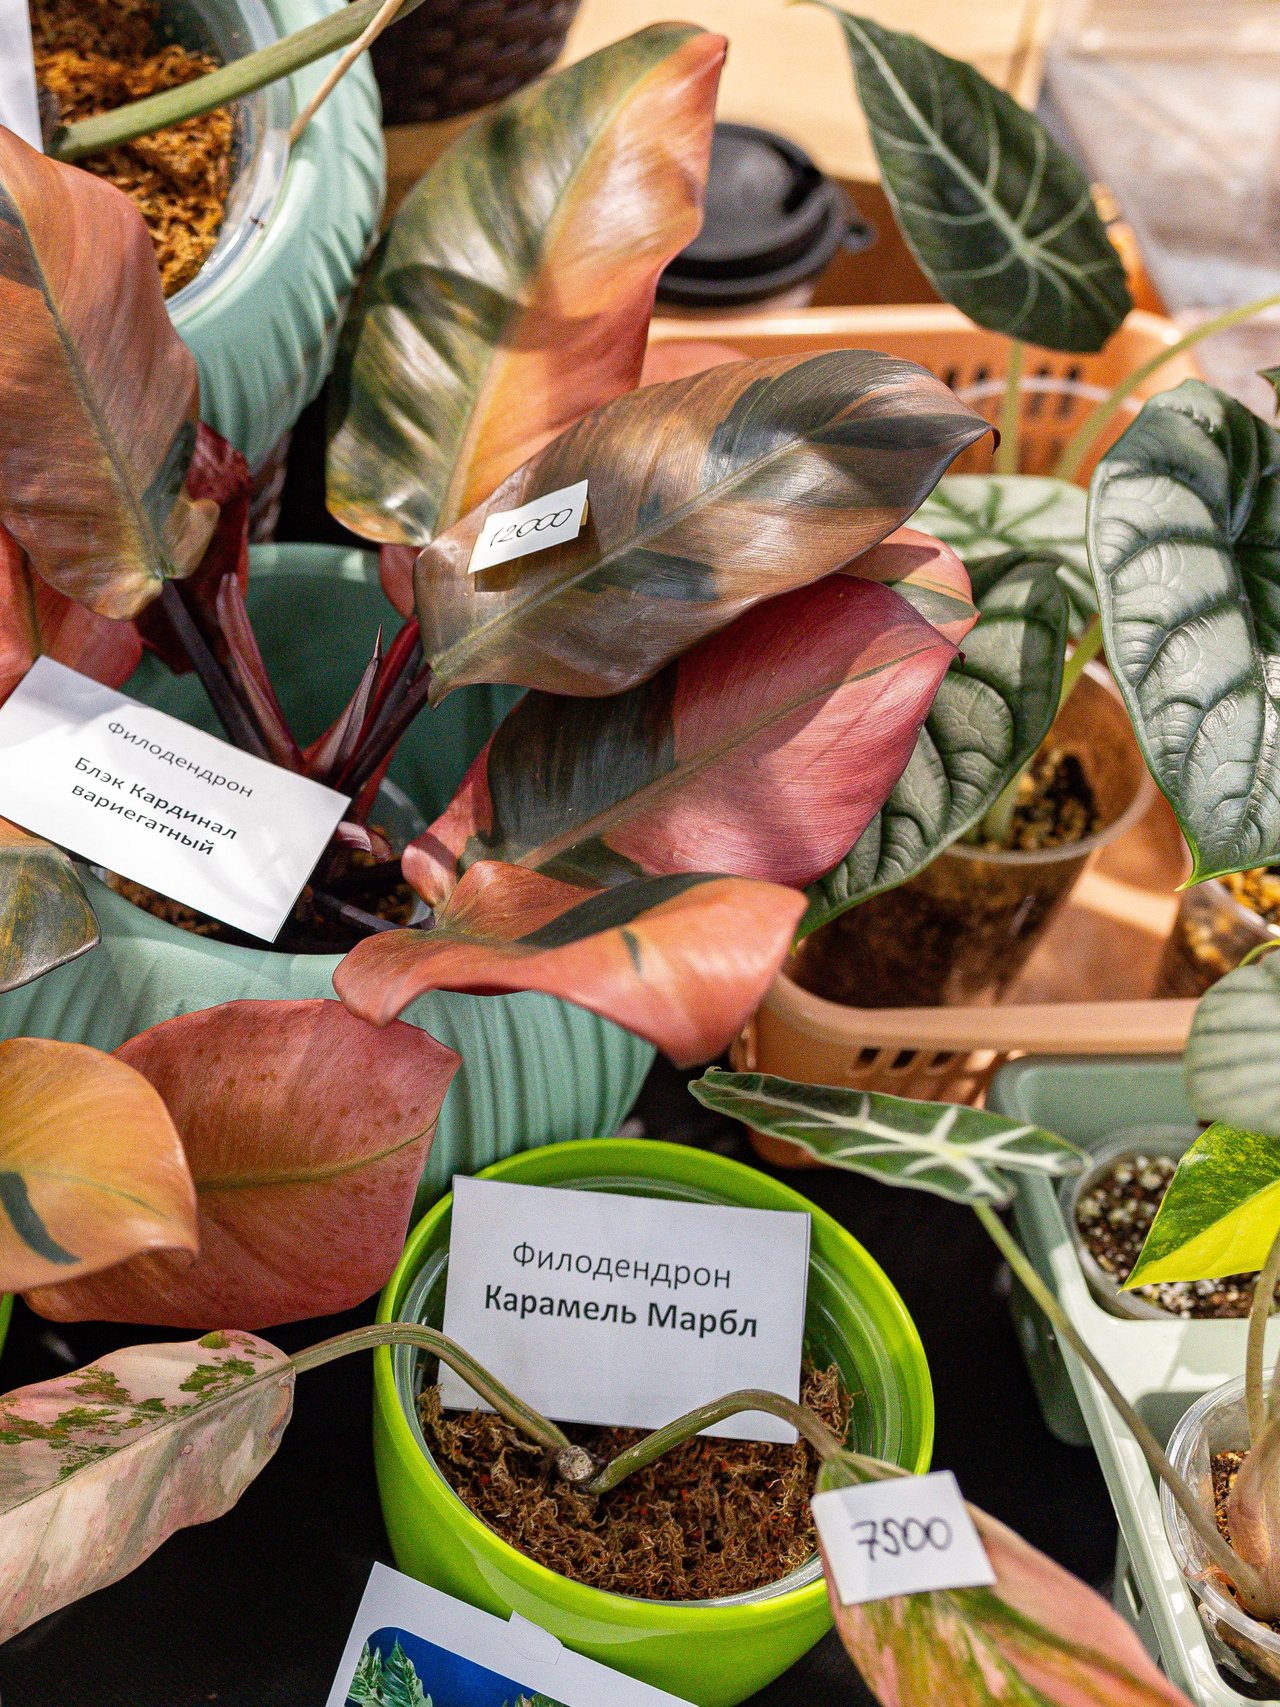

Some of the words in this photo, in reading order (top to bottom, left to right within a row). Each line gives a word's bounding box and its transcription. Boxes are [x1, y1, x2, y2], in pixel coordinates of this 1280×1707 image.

[488, 508, 574, 548] 12000
[107, 721, 254, 798] Филодендрон
[71, 784, 216, 856] вариегатный
[74, 756, 125, 790] Блэк
[129, 783, 238, 840] Кардинал
[512, 1241, 732, 1290] Филодендрон
[484, 1284, 638, 1325] Карамель
[647, 1302, 758, 1339] Марбл
[850, 1515, 954, 1563] 7500
